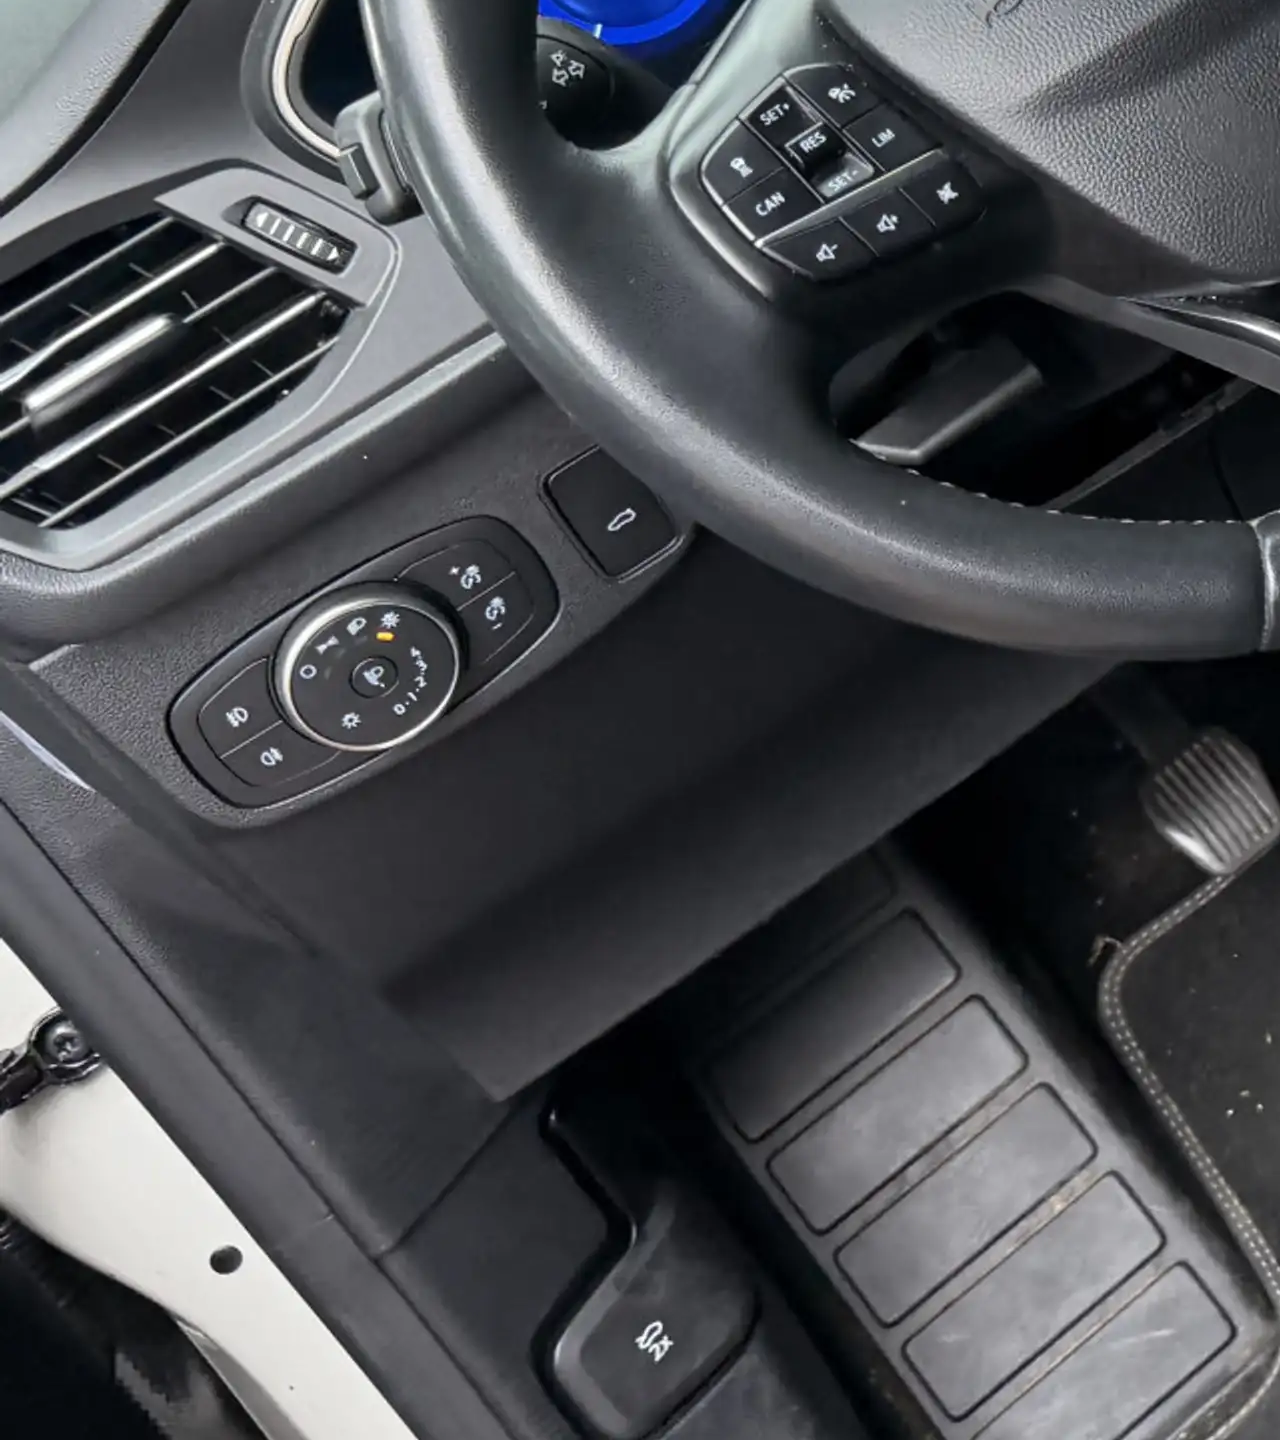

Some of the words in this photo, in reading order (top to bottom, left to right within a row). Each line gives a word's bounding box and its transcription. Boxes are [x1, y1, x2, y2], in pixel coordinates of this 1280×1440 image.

[759, 102, 790, 127] SET+
[799, 131, 828, 153] RES
[871, 129, 896, 147] LIM
[755, 192, 786, 217] CAN
